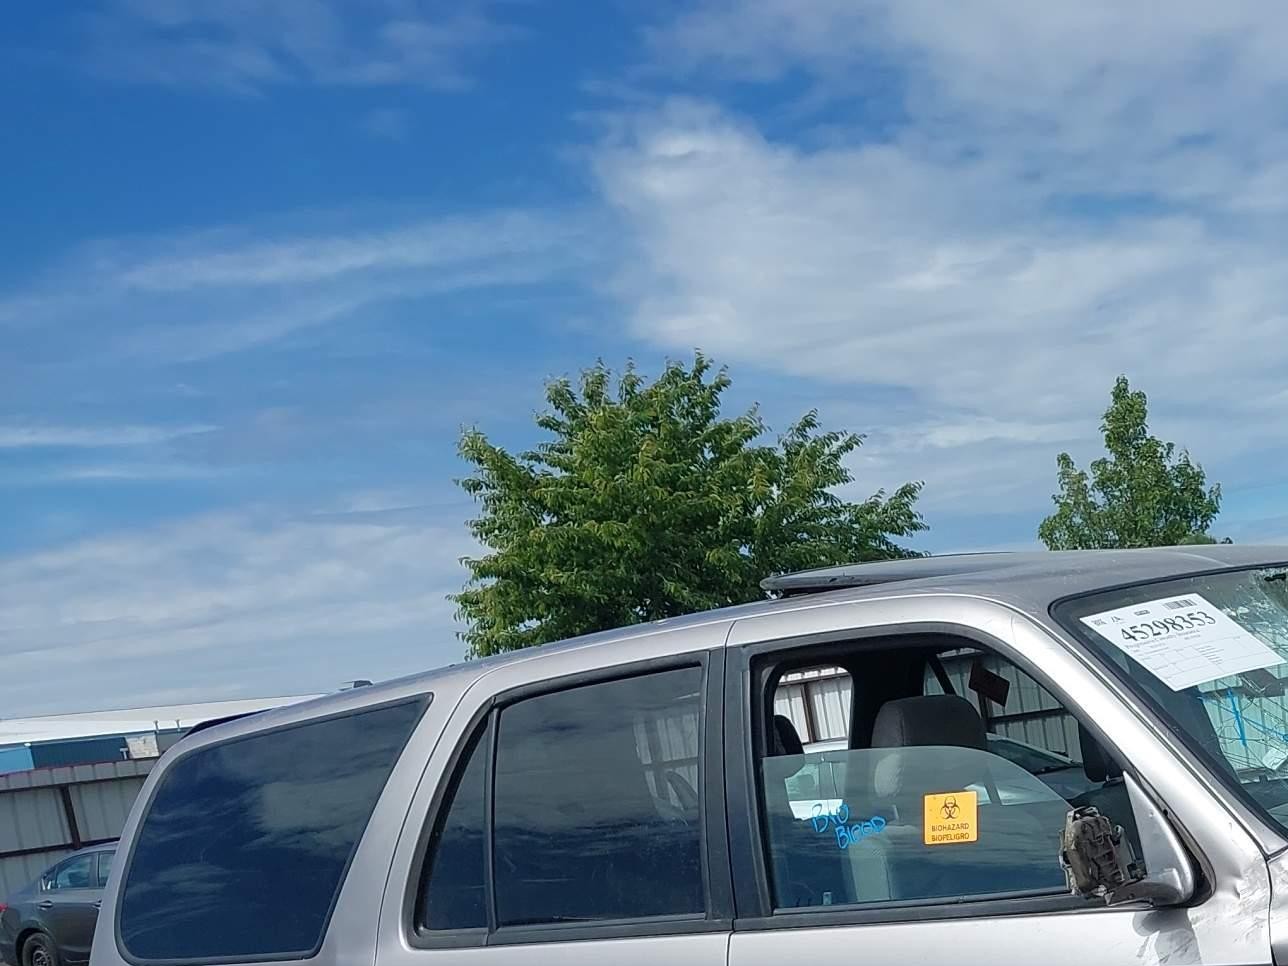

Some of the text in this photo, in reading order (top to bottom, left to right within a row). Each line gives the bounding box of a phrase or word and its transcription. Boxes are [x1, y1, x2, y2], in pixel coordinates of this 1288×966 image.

[1120, 611, 1217, 643] 45298353
[931, 822, 969, 832] BIOHAZARD
[931, 832, 969, 842] BIOPELIGRO
